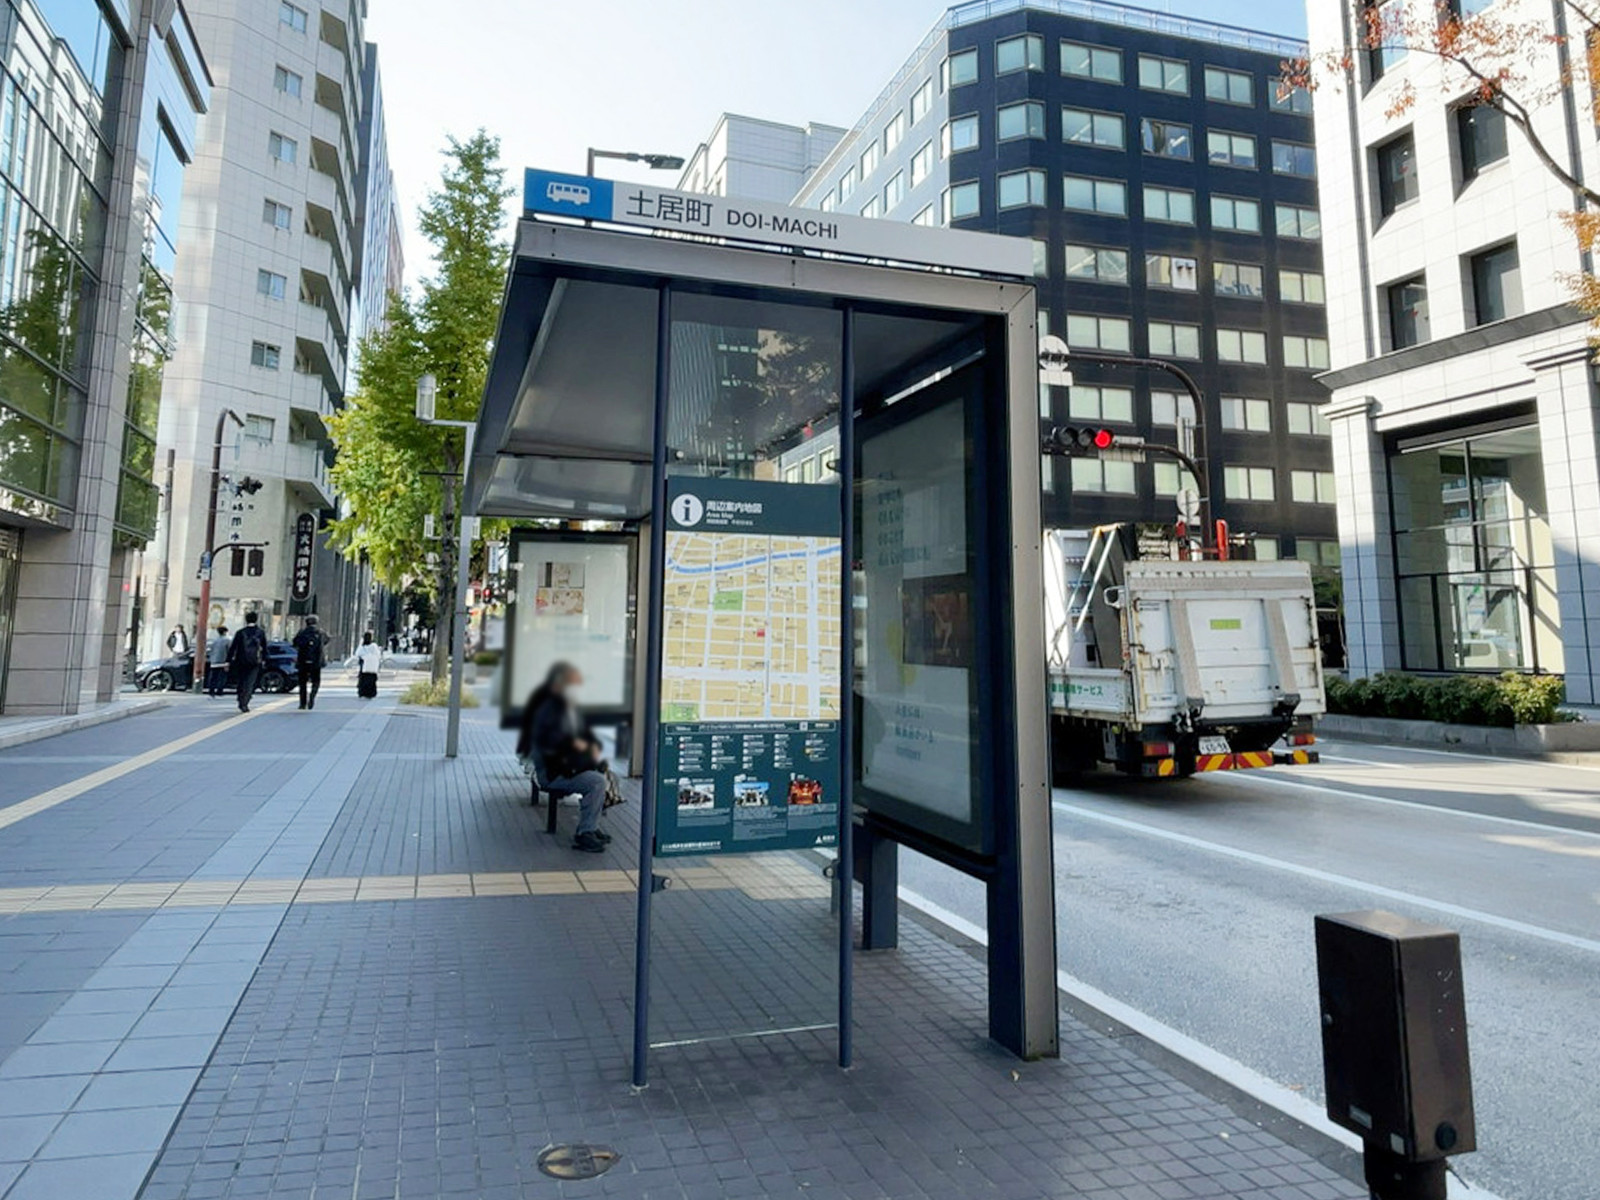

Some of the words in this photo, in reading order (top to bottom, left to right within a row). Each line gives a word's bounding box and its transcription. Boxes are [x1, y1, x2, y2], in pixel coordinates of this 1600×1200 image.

[626, 189, 714, 227] 土居町
[727, 209, 838, 240] DOI-MACHI
